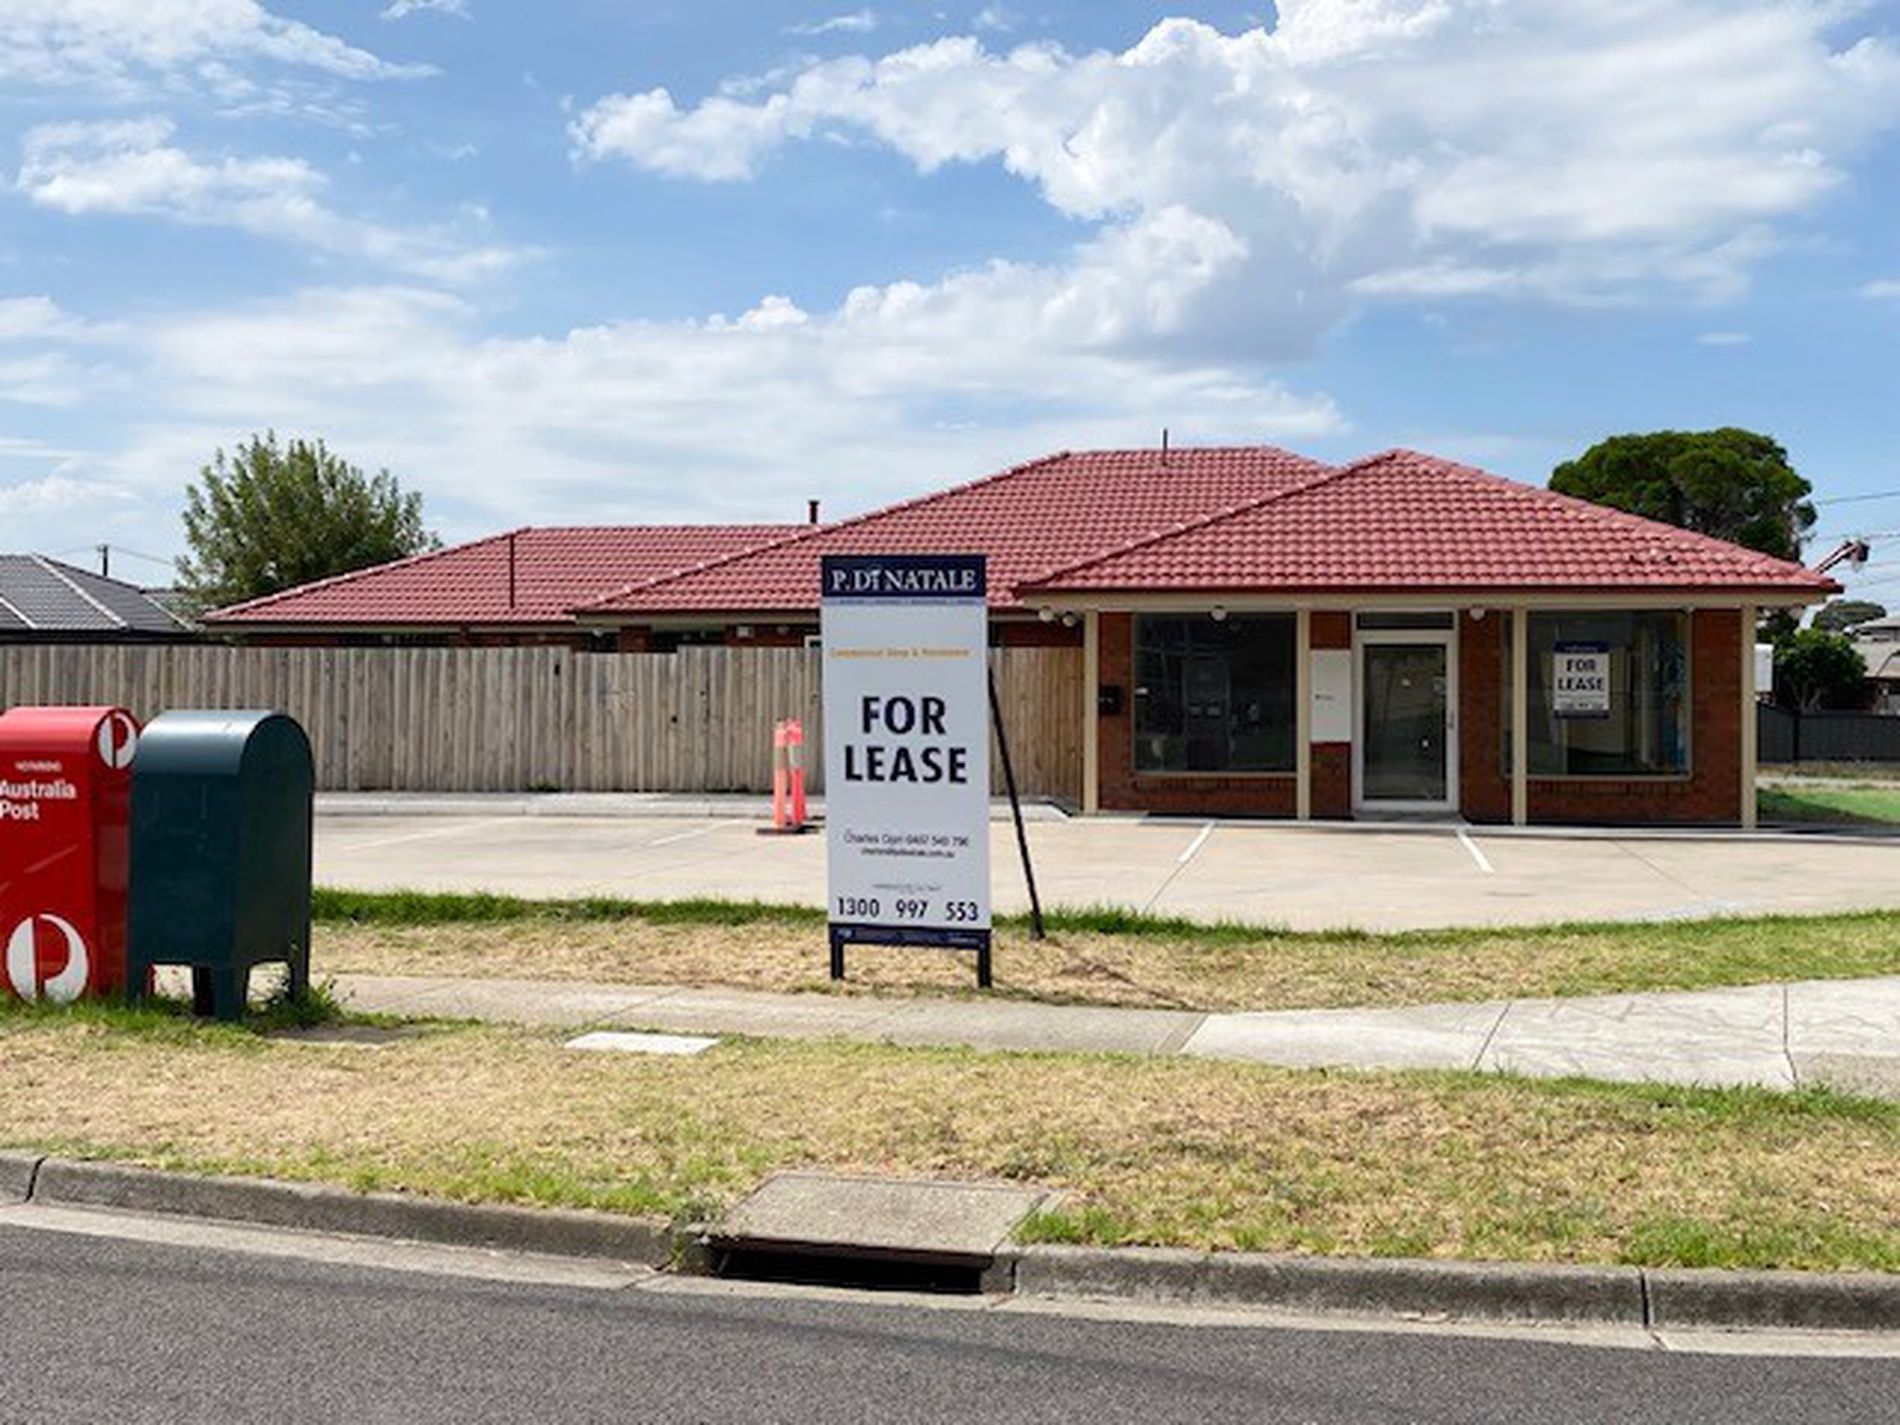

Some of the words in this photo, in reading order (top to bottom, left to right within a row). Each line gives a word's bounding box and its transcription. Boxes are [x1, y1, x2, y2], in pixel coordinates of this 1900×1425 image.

[884, 568, 977, 591] NATALE
[1567, 658, 1597, 673] FOR
[1557, 676, 1606, 692] LEASE
[862, 695, 947, 735] FOR
[844, 745, 968, 784] LEASE
[0, 779, 77, 799] Australia
[0, 800, 39, 820] Post
[838, 897, 881, 917] 1300
[895, 899, 928, 918] 997
[945, 901, 979, 921] 553
